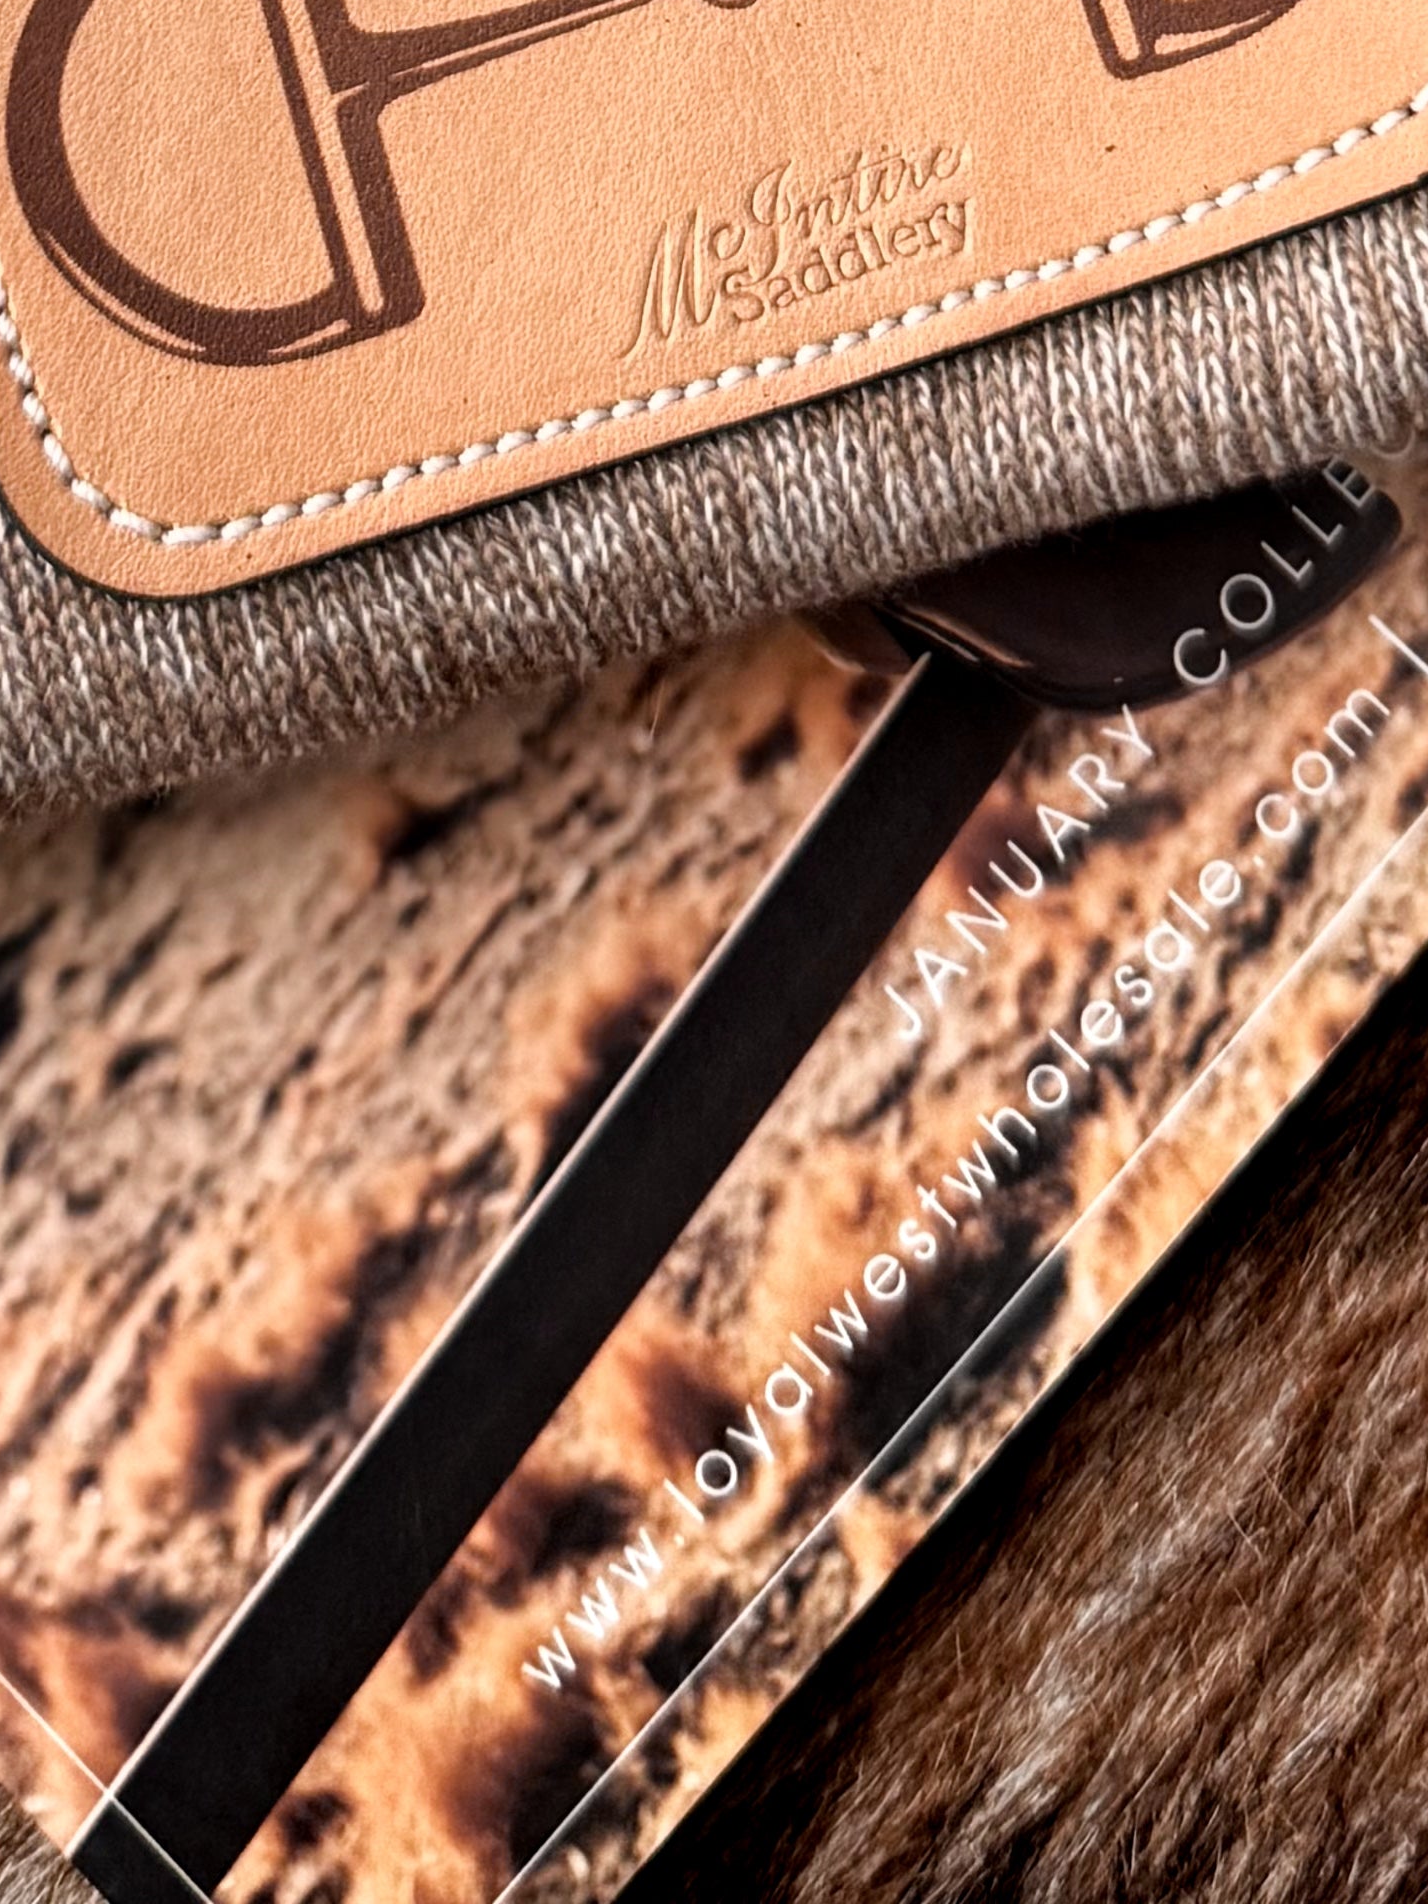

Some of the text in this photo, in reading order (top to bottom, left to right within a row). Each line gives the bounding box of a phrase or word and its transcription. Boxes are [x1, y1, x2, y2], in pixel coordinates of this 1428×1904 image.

[619, 142, 966, 360] McIntire
[720, 200, 968, 322] Saddlery
[884, 703, 1153, 1042] JANUARY
[521, 689, 1390, 1690] www.loyalwestwholesale.com
